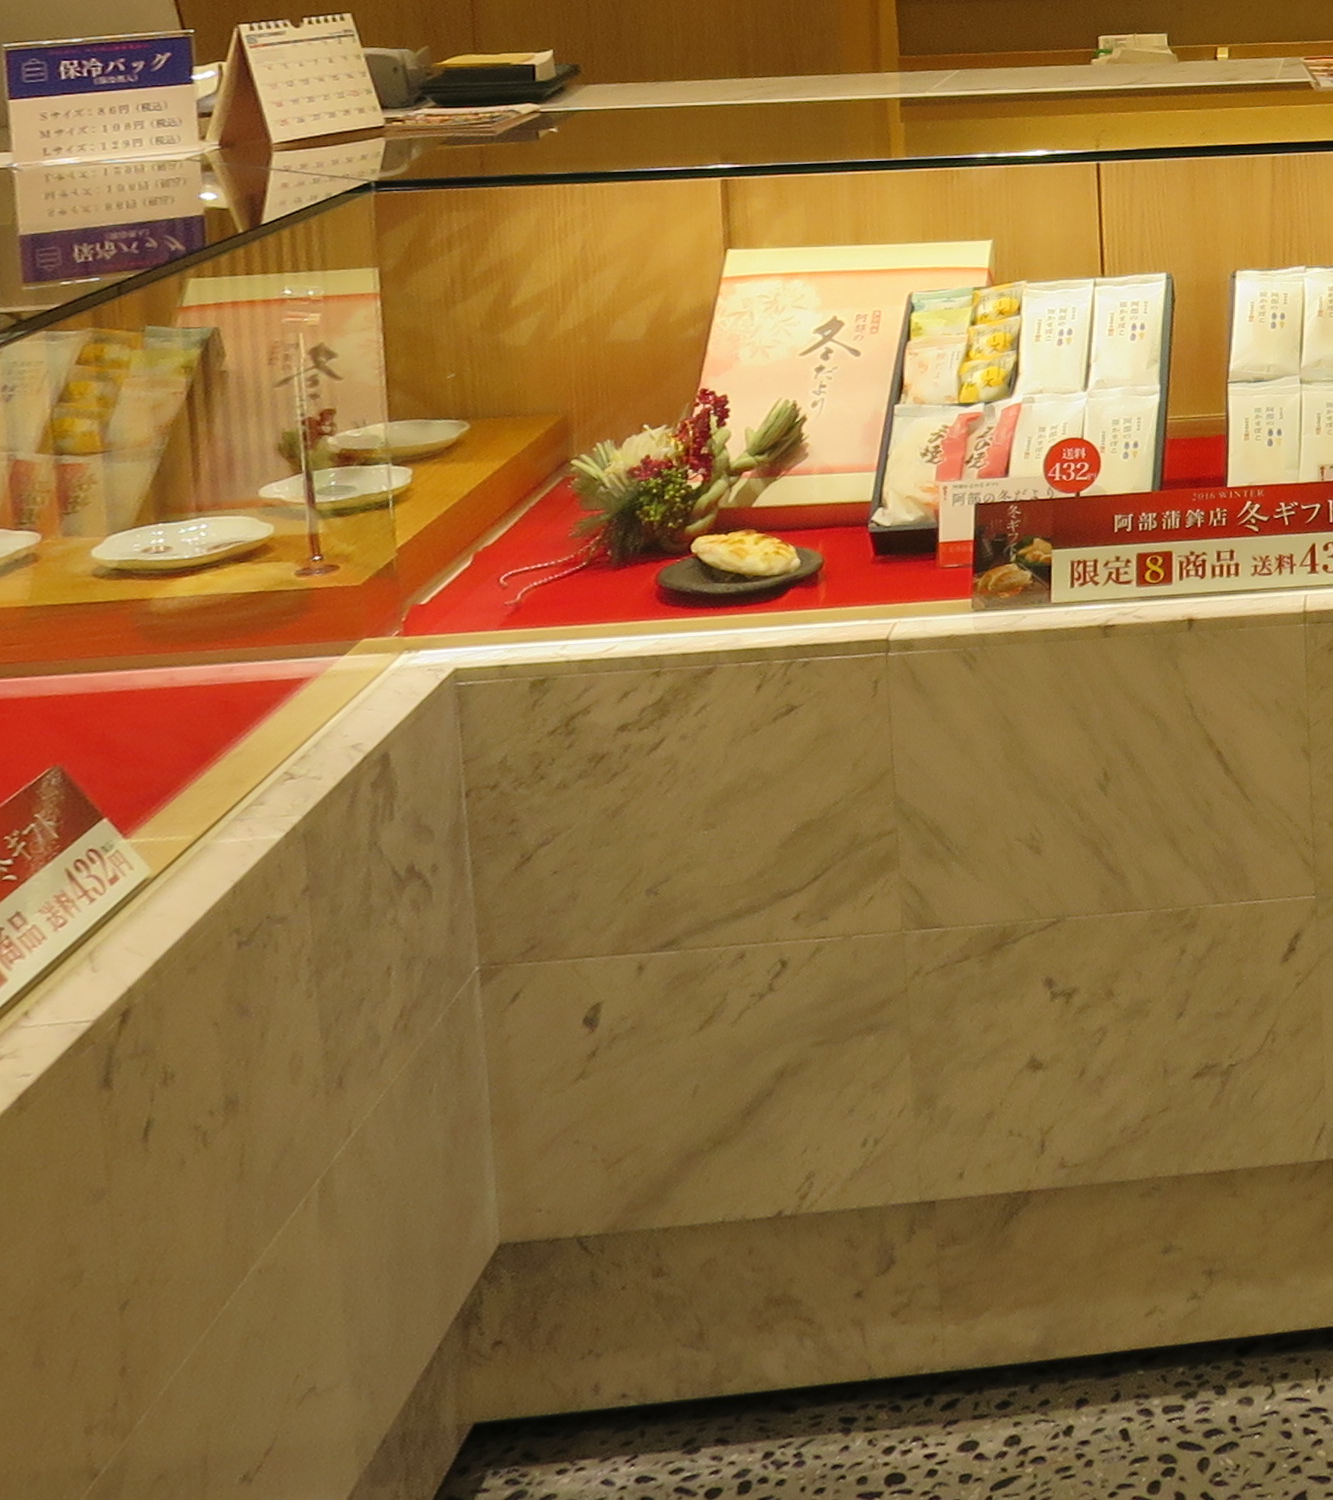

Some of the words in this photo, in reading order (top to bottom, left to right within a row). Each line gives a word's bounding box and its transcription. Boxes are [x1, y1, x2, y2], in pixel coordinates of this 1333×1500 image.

[59, 52, 173, 80] 保冷バッグ
[798, 315, 862, 418] 冬だより
[1061, 447, 1087, 460] 送料
[1218, 489, 1265, 499] WINTER
[1113, 508, 1228, 534] 阿部蒲鉾店
[1068, 549, 1241, 589] 限定8商品
